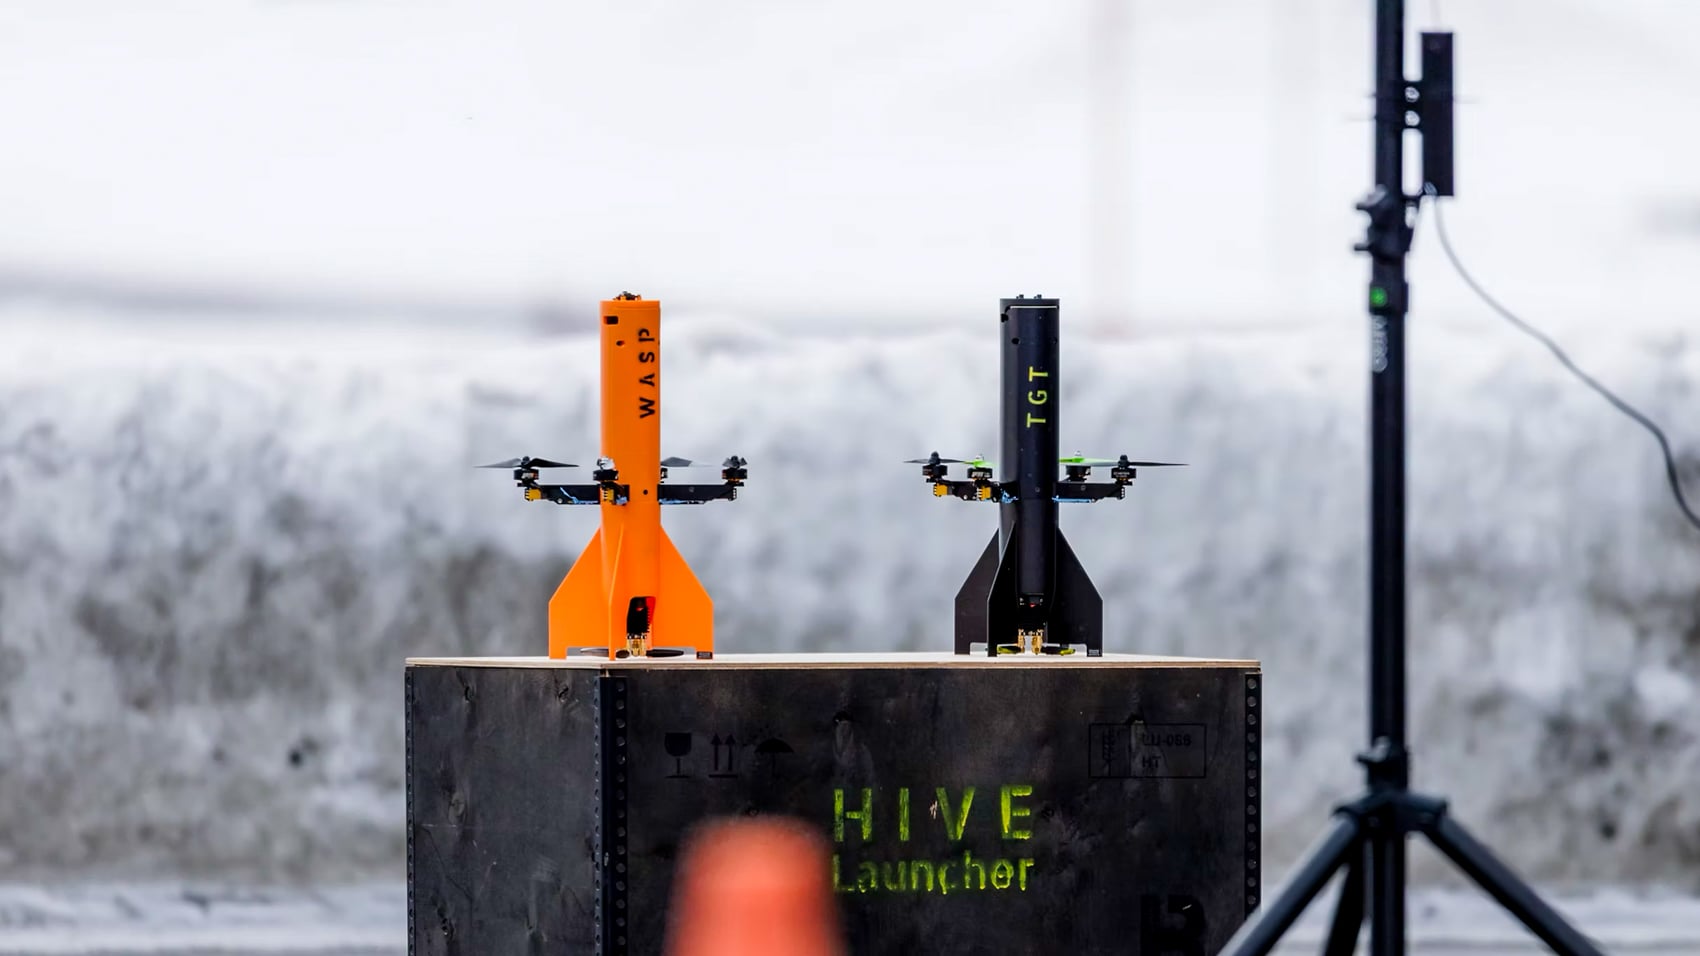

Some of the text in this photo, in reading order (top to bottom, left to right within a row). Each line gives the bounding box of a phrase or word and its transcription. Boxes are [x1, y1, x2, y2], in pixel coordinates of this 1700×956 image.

[638, 328, 656, 419] WASP
[1026, 366, 1049, 428] TGT
[834, 785, 1033, 841] HIVE
[833, 850, 1035, 895] Launcher
